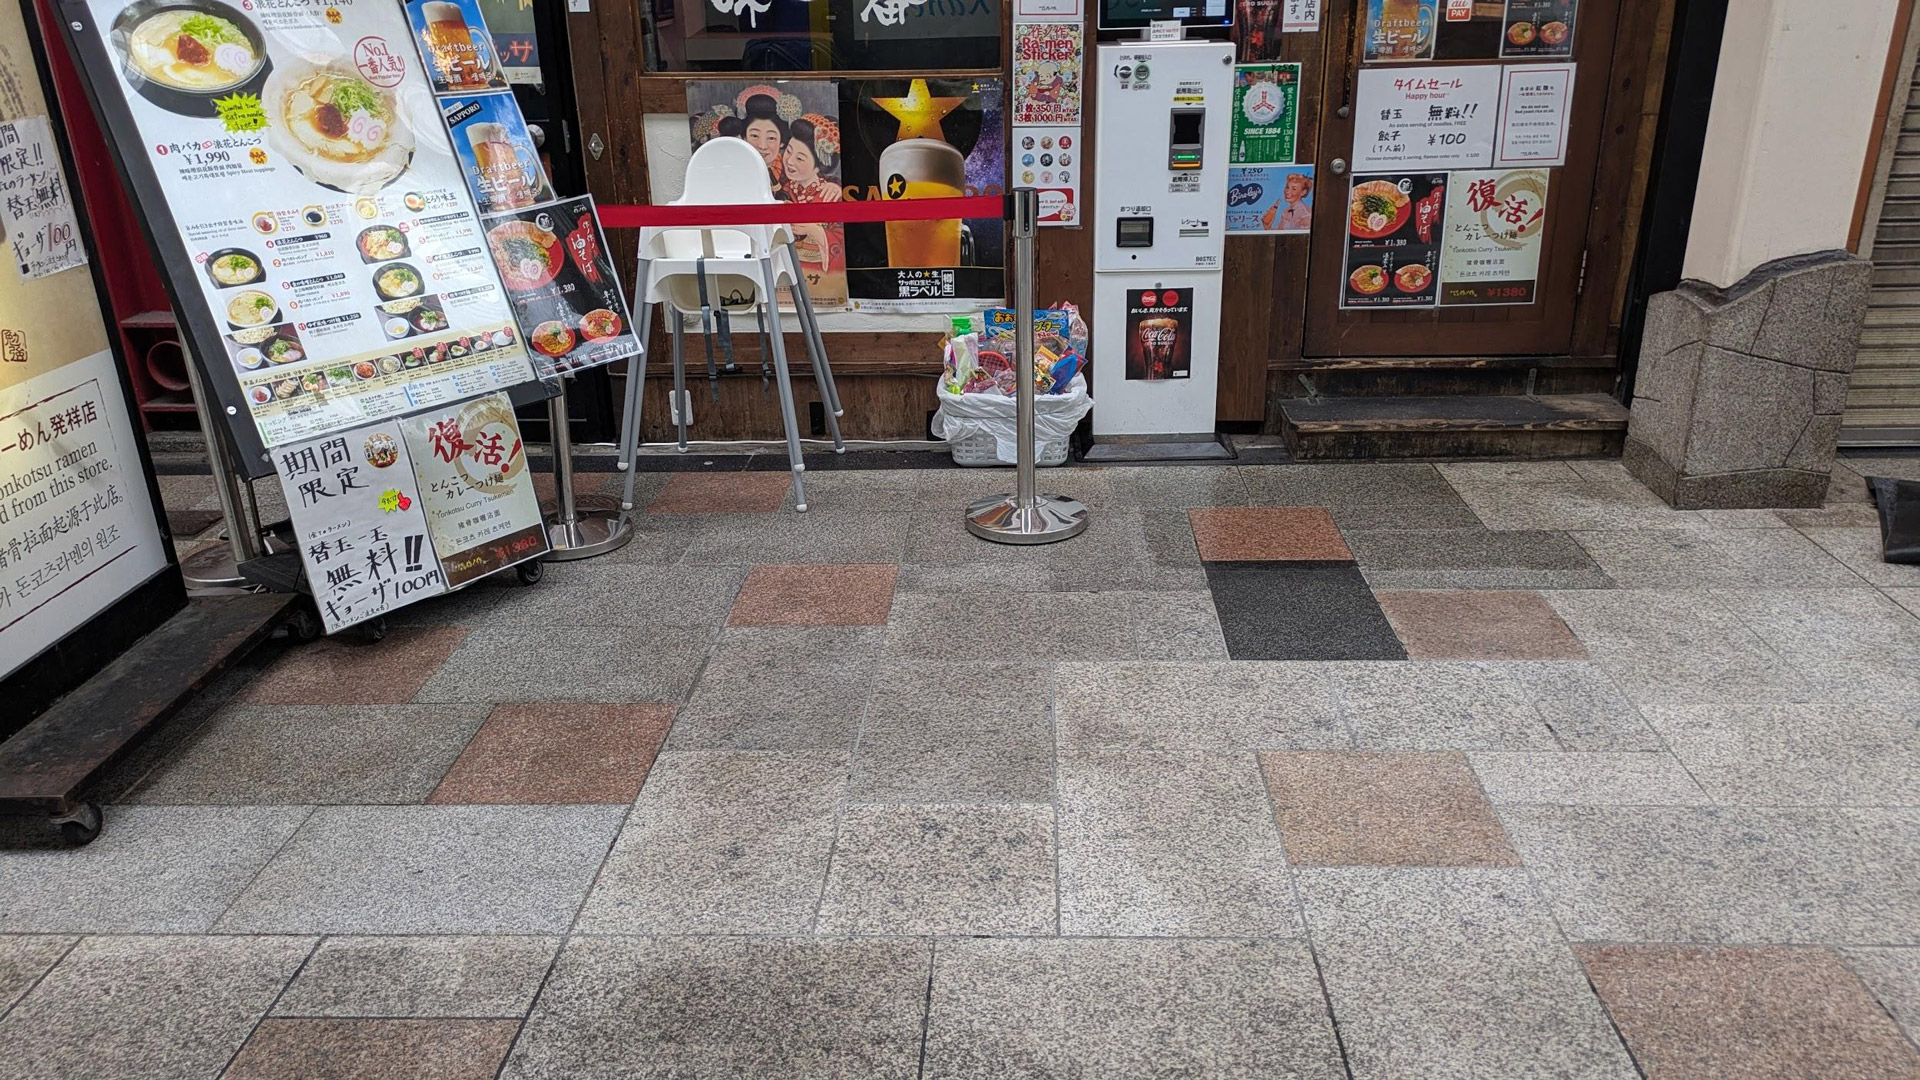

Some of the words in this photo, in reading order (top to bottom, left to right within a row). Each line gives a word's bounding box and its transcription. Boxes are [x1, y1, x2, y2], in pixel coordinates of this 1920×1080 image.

[1374, 19, 1430, 28] Draftbeer
[1022, 37, 1074, 49] Ra-men
[1371, 29, 1428, 45] 生ビール
[361, 42, 389, 57] No.1
[1022, 48, 1072, 60] Sticker
[1394, 78, 1463, 91] タイムセール
[1405, 92, 1428, 100] Happy
[449, 102, 480, 124] SAPPORO
[1380, 108, 1403, 121] 替玉
[1427, 103, 1478, 121] 無料!!
[1244, 127, 1264, 135] SINCE
[1265, 127, 1281, 135] 1884
[1378, 130, 1401, 141] 餃子
[1427, 132, 1467, 146] ¥100
[213, 138, 262, 148] 浪花とんこつ
[183, 150, 230, 165] ¥1,990
[472, 160, 530, 176] Draftbeer
[477, 171, 536, 194] 生ビール
[1466, 178, 1545, 233] 復活!
[1419, 200, 1431, 235] 油そば
[1455, 223, 1489, 233] とんこつ
[1464, 230, 1518, 241] カレーつけ麺
[572, 234, 593, 275] 油そば
[898, 286, 941, 297] 黒ラベル
[1488, 288, 1527, 297] ¥1380
[1142, 327, 1176, 341] Coca-Cola
[428, 417, 522, 474] 復活!
[55, 441, 97, 473] ramen
[280, 437, 351, 480] 期間
[11, 490, 48, 522] from
[49, 474, 76, 501] this
[78, 457, 113, 490] store.
[298, 464, 370, 508] 限定
[430, 473, 469, 493] とんこつ
[446, 472, 505, 500] カレーつけ麺
[436, 505, 465, 519] Tonkotsu
[465, 500, 483, 510] Curry
[483, 488, 514, 504] Tsukemen
[16, 537, 95, 598] 돈코츠라멘의
[95, 524, 121, 550] 원조
